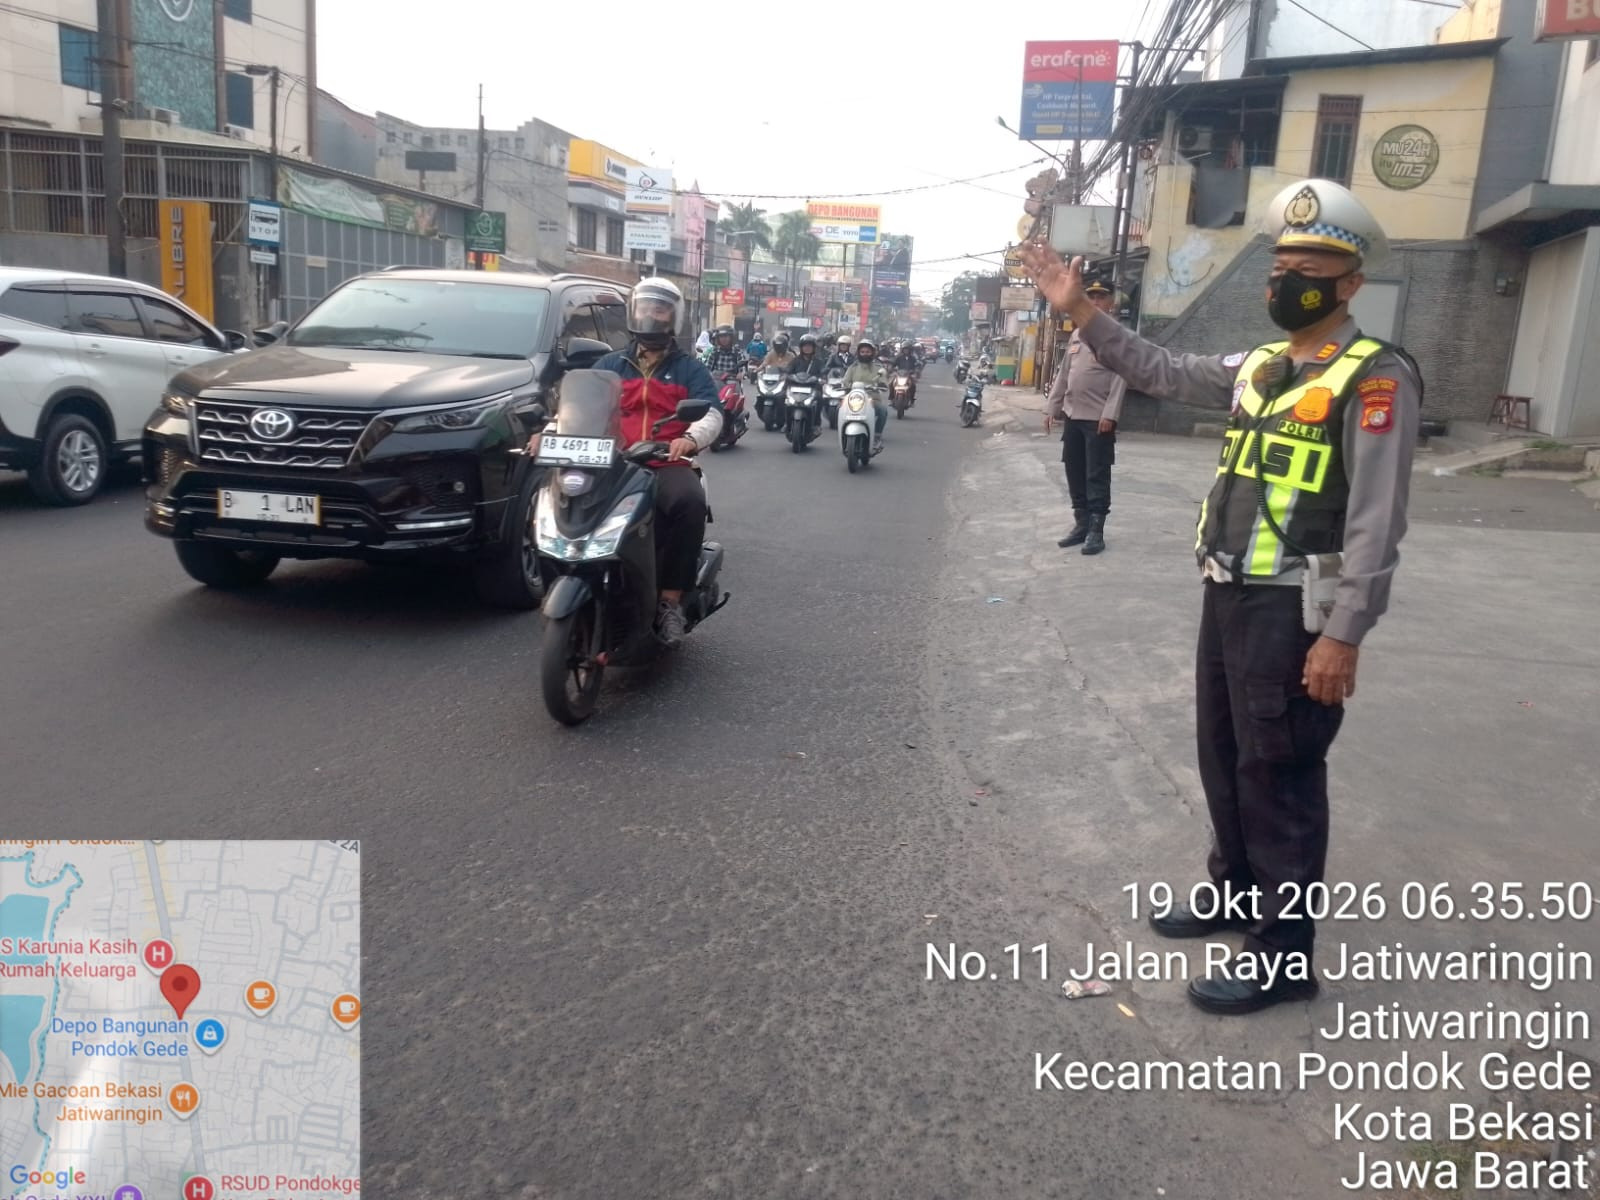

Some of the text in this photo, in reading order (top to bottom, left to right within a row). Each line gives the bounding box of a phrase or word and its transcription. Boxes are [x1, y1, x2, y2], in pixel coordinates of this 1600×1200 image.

[250, 225, 278, 236] STOP
[1279, 420, 1320, 438] POLRI
[543, 438, 612, 453] AB 4691 UR
[224, 491, 314, 514] B 1 LAN
